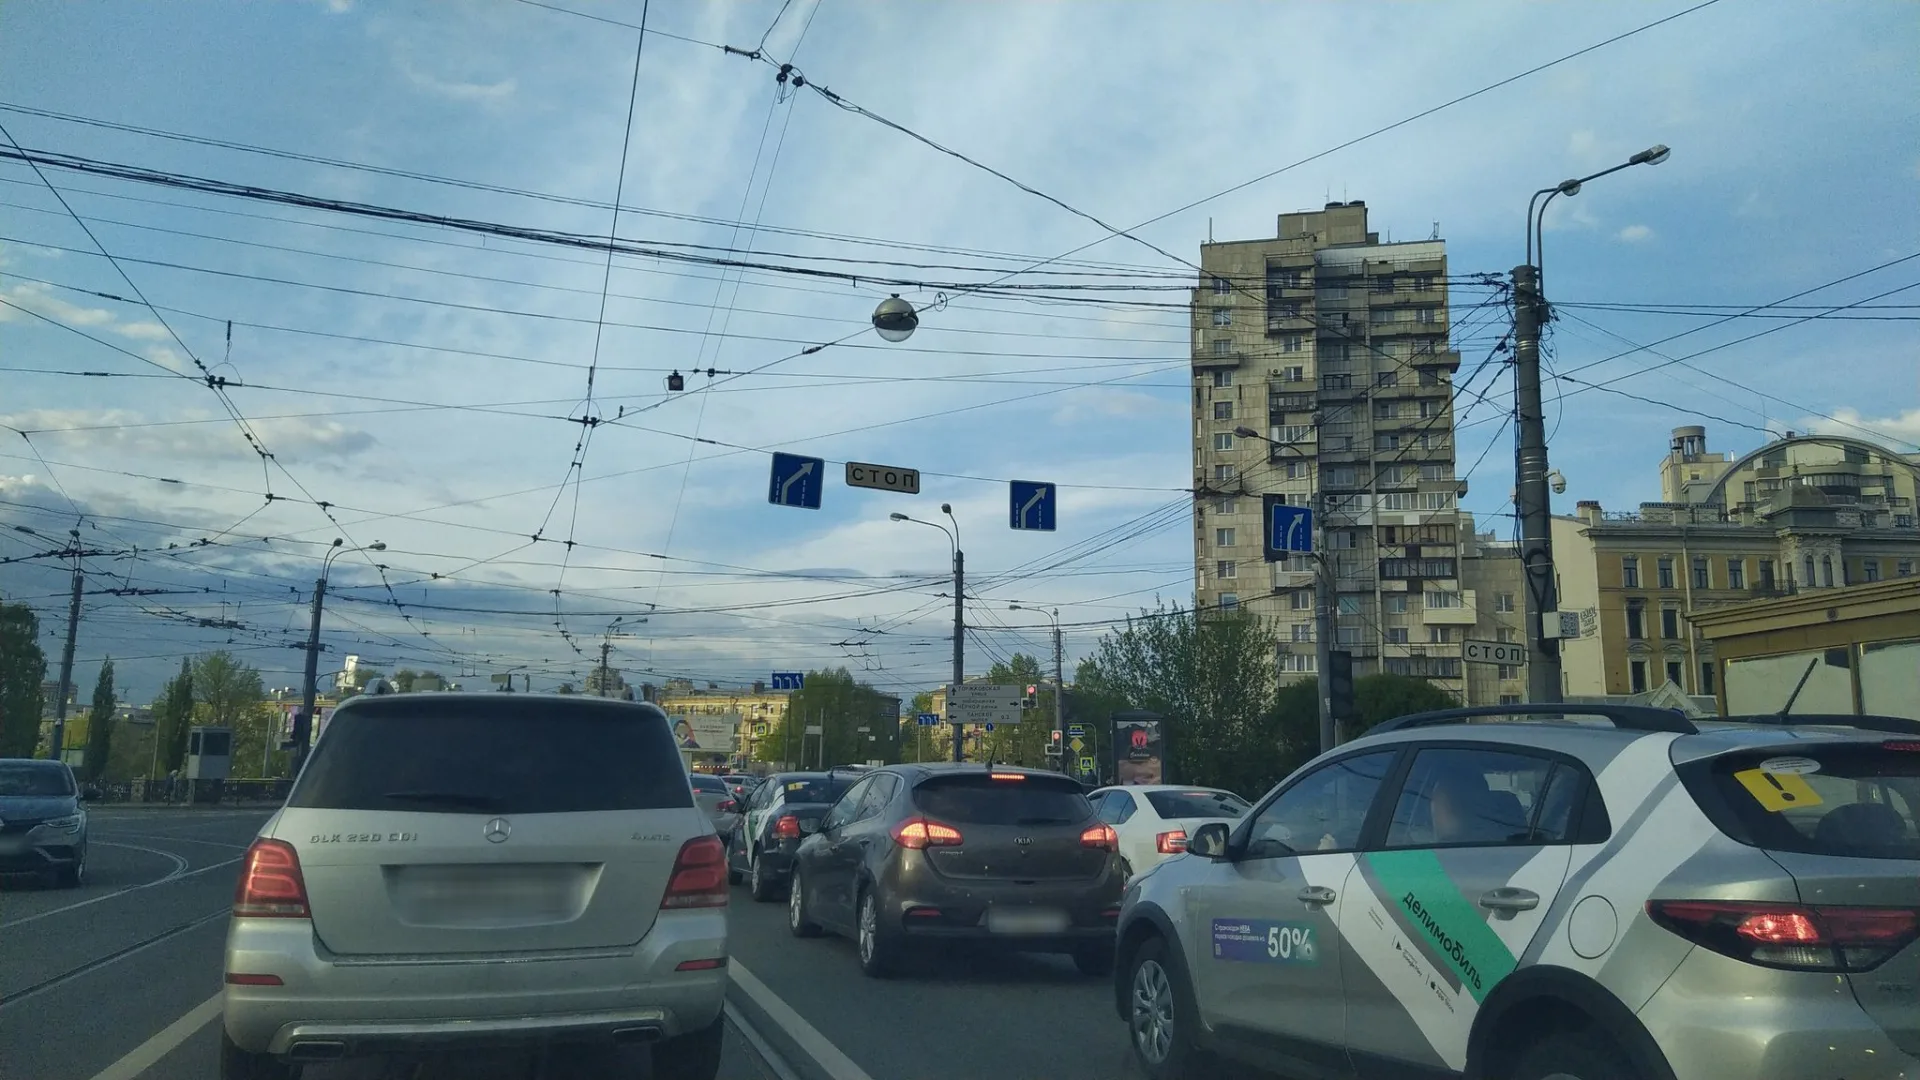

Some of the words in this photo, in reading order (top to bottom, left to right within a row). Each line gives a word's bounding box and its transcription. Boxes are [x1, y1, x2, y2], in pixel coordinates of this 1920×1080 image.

[852, 468, 914, 487] СТОП
[1468, 645, 1519, 661] СТОП
[308, 834, 341, 844] GLK
[346, 833, 382, 843] 220
[388, 832, 419, 842] CDI
[1016, 836, 1033, 845] KIA
[1267, 927, 1313, 959] 50%
[1402, 891, 1482, 990] делимобиль
